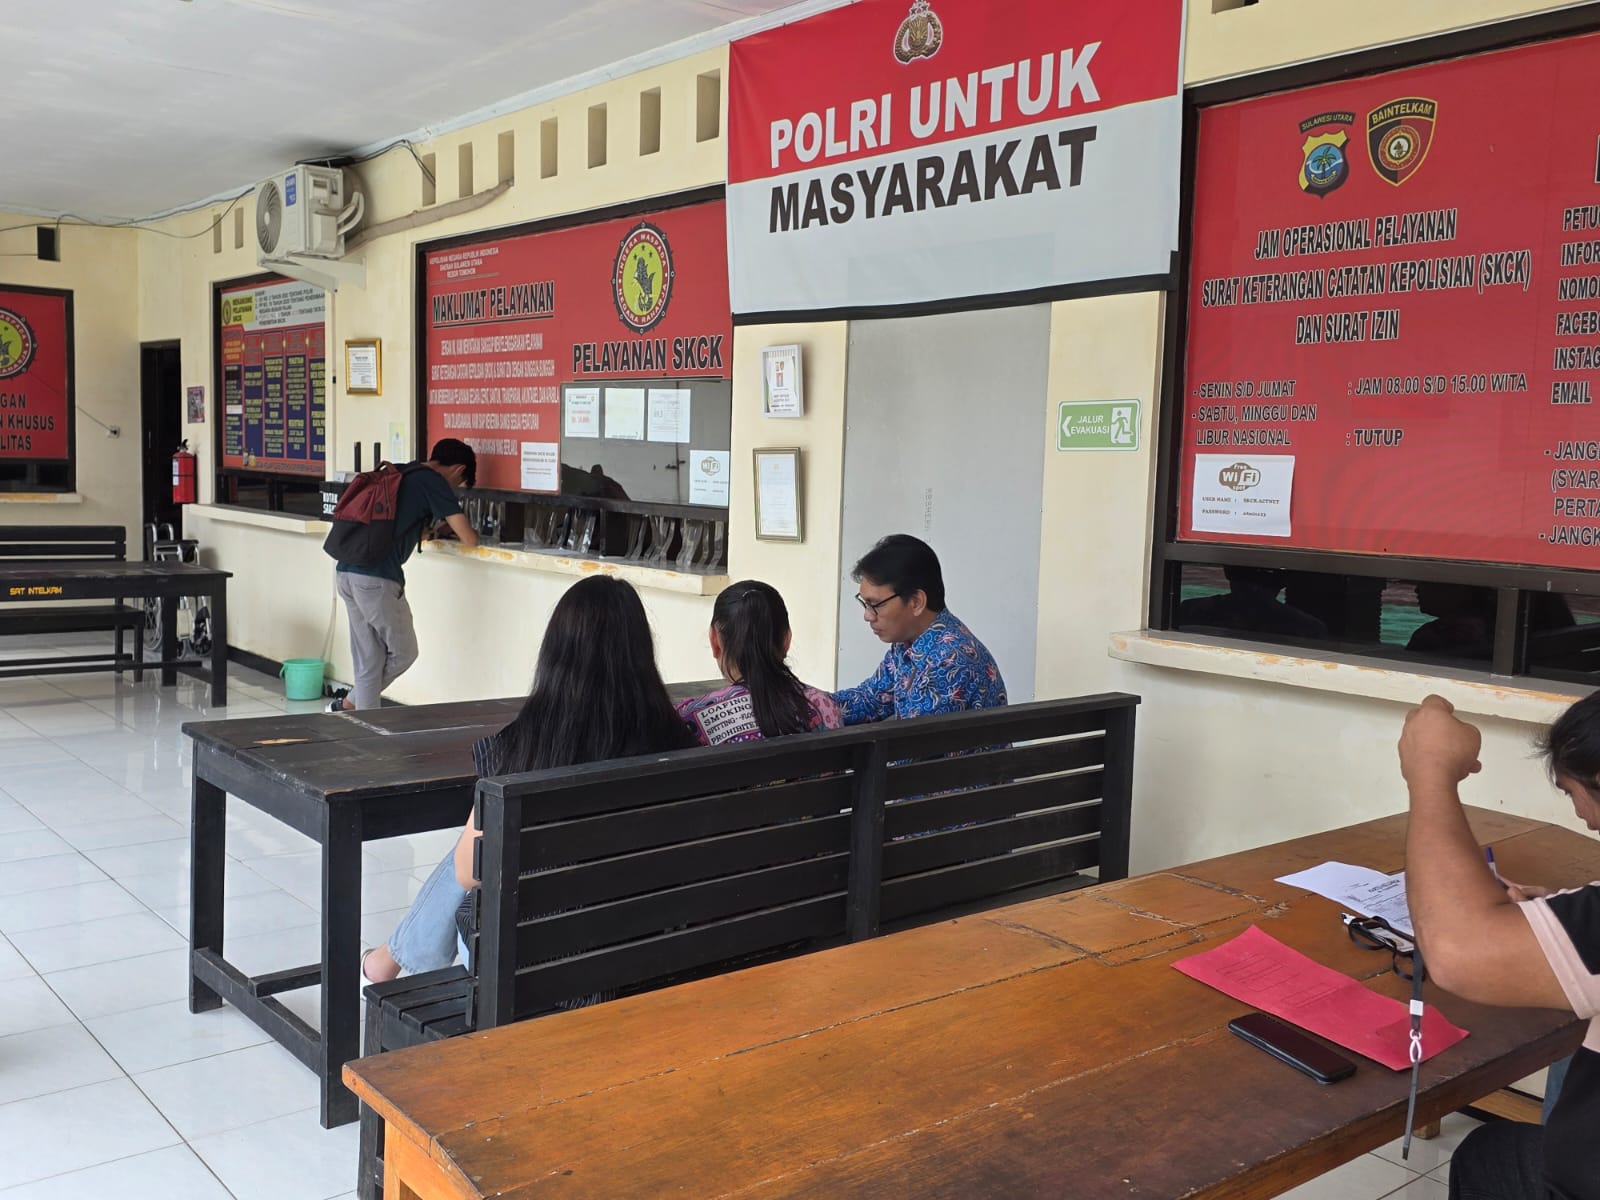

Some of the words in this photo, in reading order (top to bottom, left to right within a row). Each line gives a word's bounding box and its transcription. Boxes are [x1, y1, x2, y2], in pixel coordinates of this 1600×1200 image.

[771, 93, 892, 169] POLRI
[909, 41, 1102, 139] UNTUK
[1371, 102, 1433, 125] BAINTELKAM
[1302, 115, 1333, 131] SULAWESI
[1333, 113, 1353, 122] UTARA
[769, 125, 1097, 233] MASYARAKAT
[1563, 205, 1600, 232] PETU
[1255, 229, 1280, 260] JAM
[1283, 218, 1371, 257] OPERASIONAL
[1374, 208, 1458, 247] PELAYANAN
[1202, 277, 1240, 308] SURAT
[1241, 269, 1324, 304] KETERANGAN
[1327, 263, 1386, 297] CATATAN
[1388, 255, 1475, 293] KEPOLISIAN
[1478, 249, 1531, 295] (SKCK)
[1558, 275, 1600, 301] NOMO
[433, 288, 487, 323] MAKLUMAT
[489, 280, 554, 318] PELAYANAN
[1296, 314, 1322, 345] DAN
[1325, 311, 1368, 343] SURAT
[1370, 309, 1400, 341] IZIN
[1556, 311, 1600, 336] FACEB
[573, 338, 667, 374] PELAYANAN
[672, 335, 724, 370] SKCK
[1199, 382, 1232, 398] SENIN
[1235, 381, 1254, 398] S/D
[1256, 380, 1296, 397] JUMAT
[1355, 376, 1382, 395] JAM
[1386, 376, 1420, 395] 08.00
[1423, 375, 1447, 394] S/D
[1450, 374, 1486, 393] 15.00
[1490, 373, 1528, 393] WITA
[1551, 381, 1592, 404] EMAIL
[7, 414, 55, 431] KHUSUS
[1078, 415, 1104, 424] JALUR
[1198, 405, 1238, 424] SABTU,
[1242, 405, 1288, 421] MINGGU
[1290, 403, 1317, 421] DAN
[1070, 426, 1110, 435] EVAKUASI
[1196, 430, 1230, 445] LIBUR
[1232, 429, 1291, 445] NASIONAL
[1354, 429, 1404, 447] TUTUP
[1554, 441, 1600, 461] JANG
[1551, 470, 1600, 493] (SYAR
[711, 721, 758, 745] PROHIBITE
